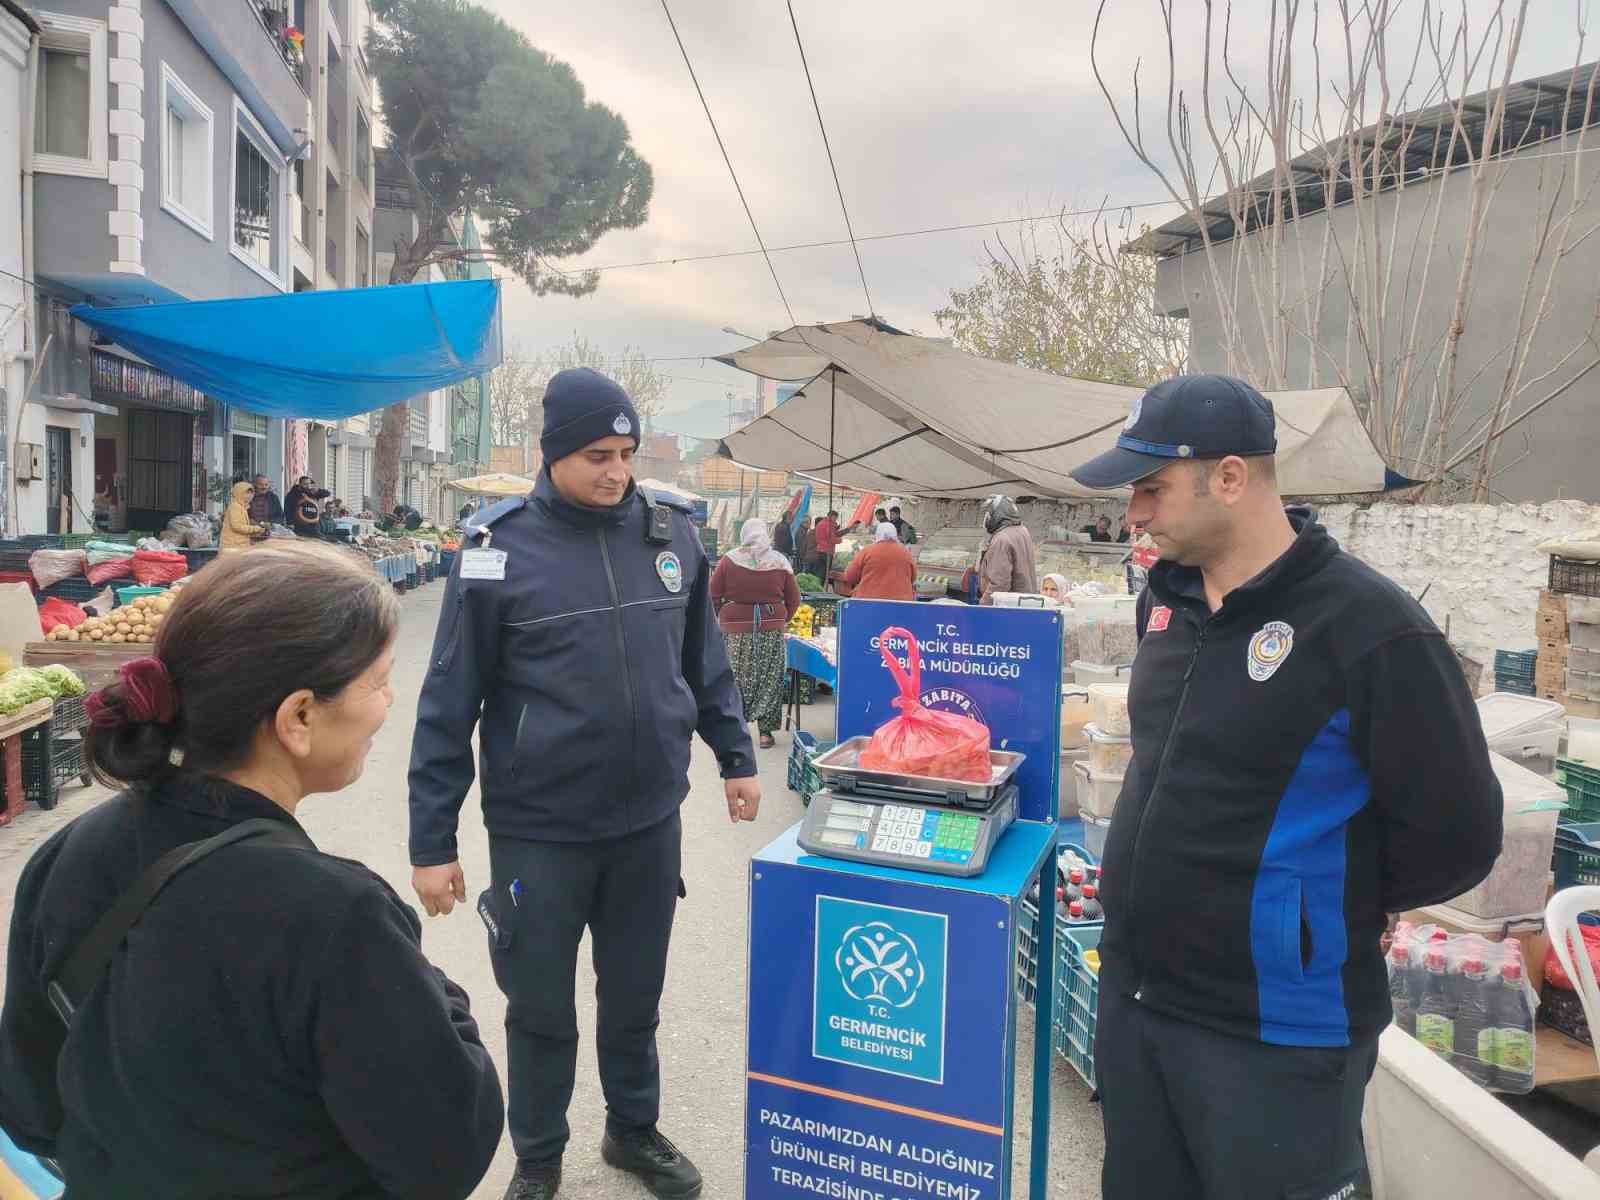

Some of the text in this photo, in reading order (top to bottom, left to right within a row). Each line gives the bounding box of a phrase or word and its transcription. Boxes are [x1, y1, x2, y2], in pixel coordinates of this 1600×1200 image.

[936, 624, 959, 636] T.C.
[870, 636, 1030, 660] GERMNCİK BELEDİYESİ
[930, 658, 1020, 678] MÜDÜRLÜĞÜ
[867, 1004, 891, 1019] T.C.
[829, 1015, 927, 1047] GERMENCİK
[841, 1036, 913, 1061] BELEDİYESİ
[760, 1109, 994, 1180] PAZARIMIZDAN ALDIĞINIZ
[771, 1136, 980, 1200] ÜRÜNLERİ BELEDİYEMİZ
